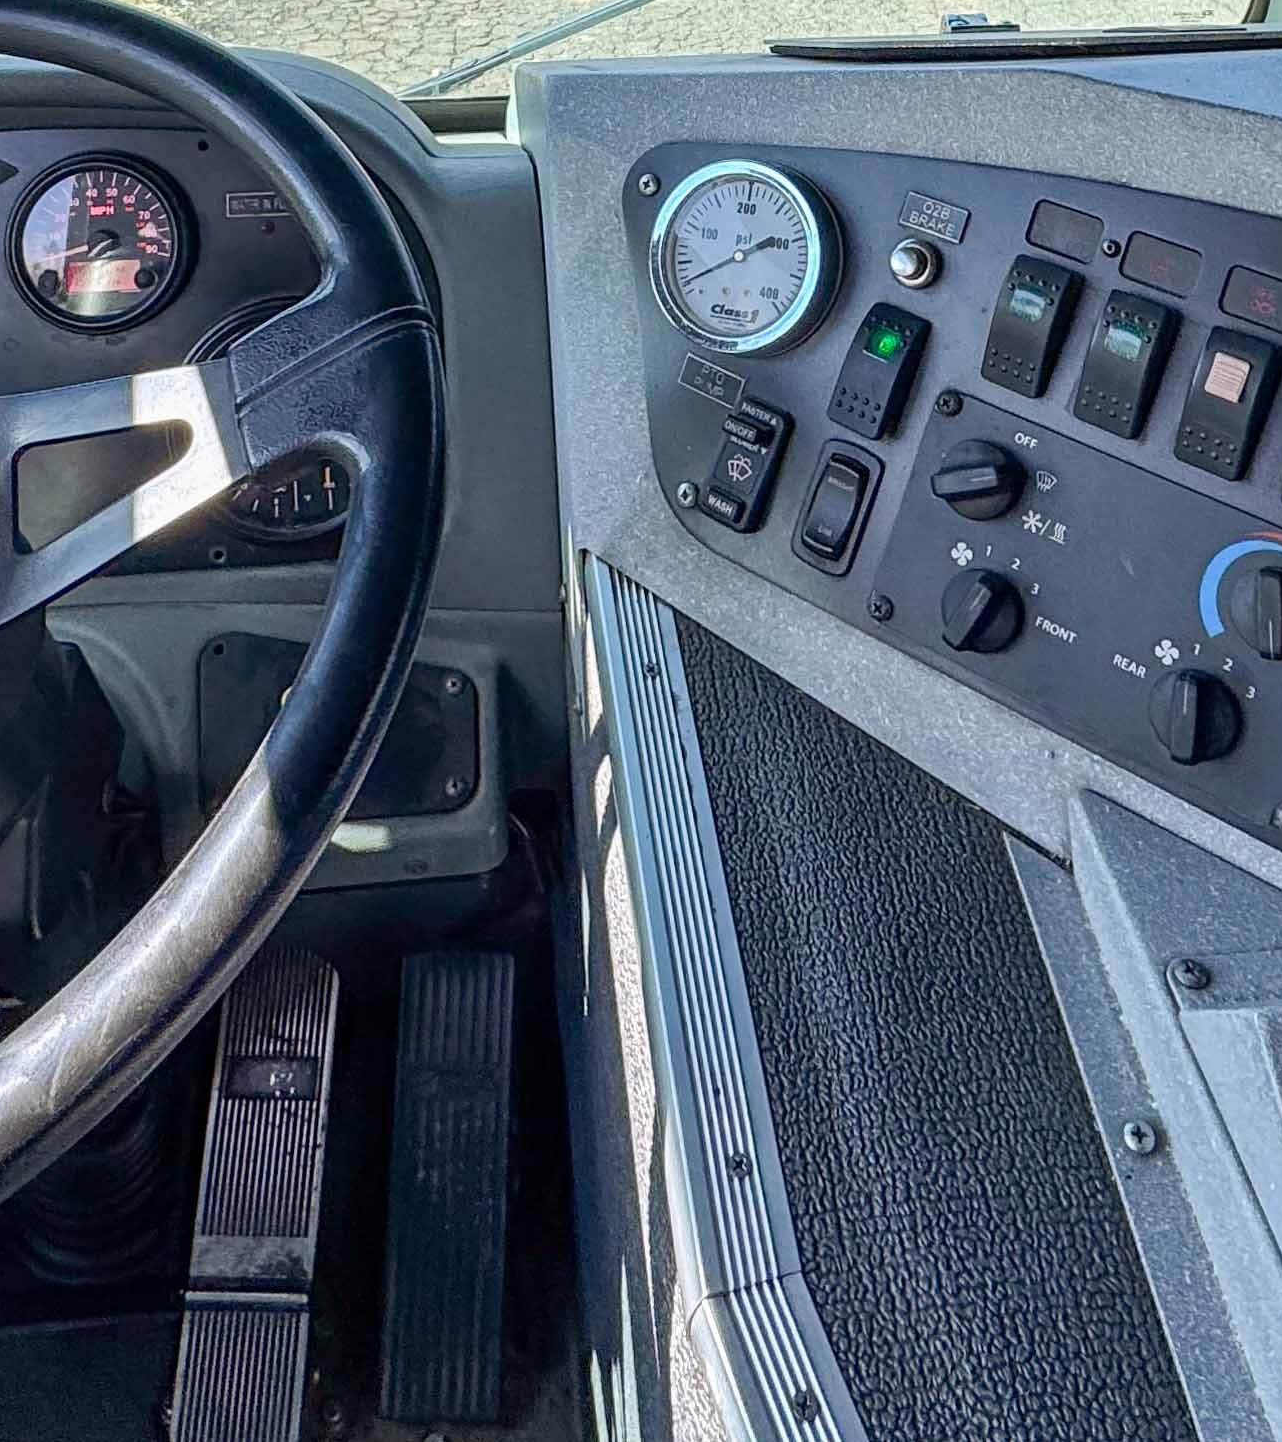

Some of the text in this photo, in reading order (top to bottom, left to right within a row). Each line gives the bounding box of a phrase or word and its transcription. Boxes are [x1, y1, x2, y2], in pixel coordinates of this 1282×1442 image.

[90, 204, 114, 217] MPH
[737, 202, 757, 215] 200
[909, 210, 956, 237] BRAKE
[701, 227, 718, 240] 100
[736, 233, 752, 247] psi
[759, 286, 780, 300] 400
[724, 420, 757, 442] ON/OFF
[1015, 432, 1038, 449] OFF
[707, 493, 735, 517] WASH
[986, 545, 993, 557] 1
[1011, 558, 1021, 570] 2
[1031, 583, 1040, 595] 3
[1035, 616, 1078, 643] FRONT
[1194, 644, 1201, 656] 1
[1113, 654, 1146, 678] REAR
[1223, 658, 1233, 672] 2
[1246, 686, 1256, 699] 3
